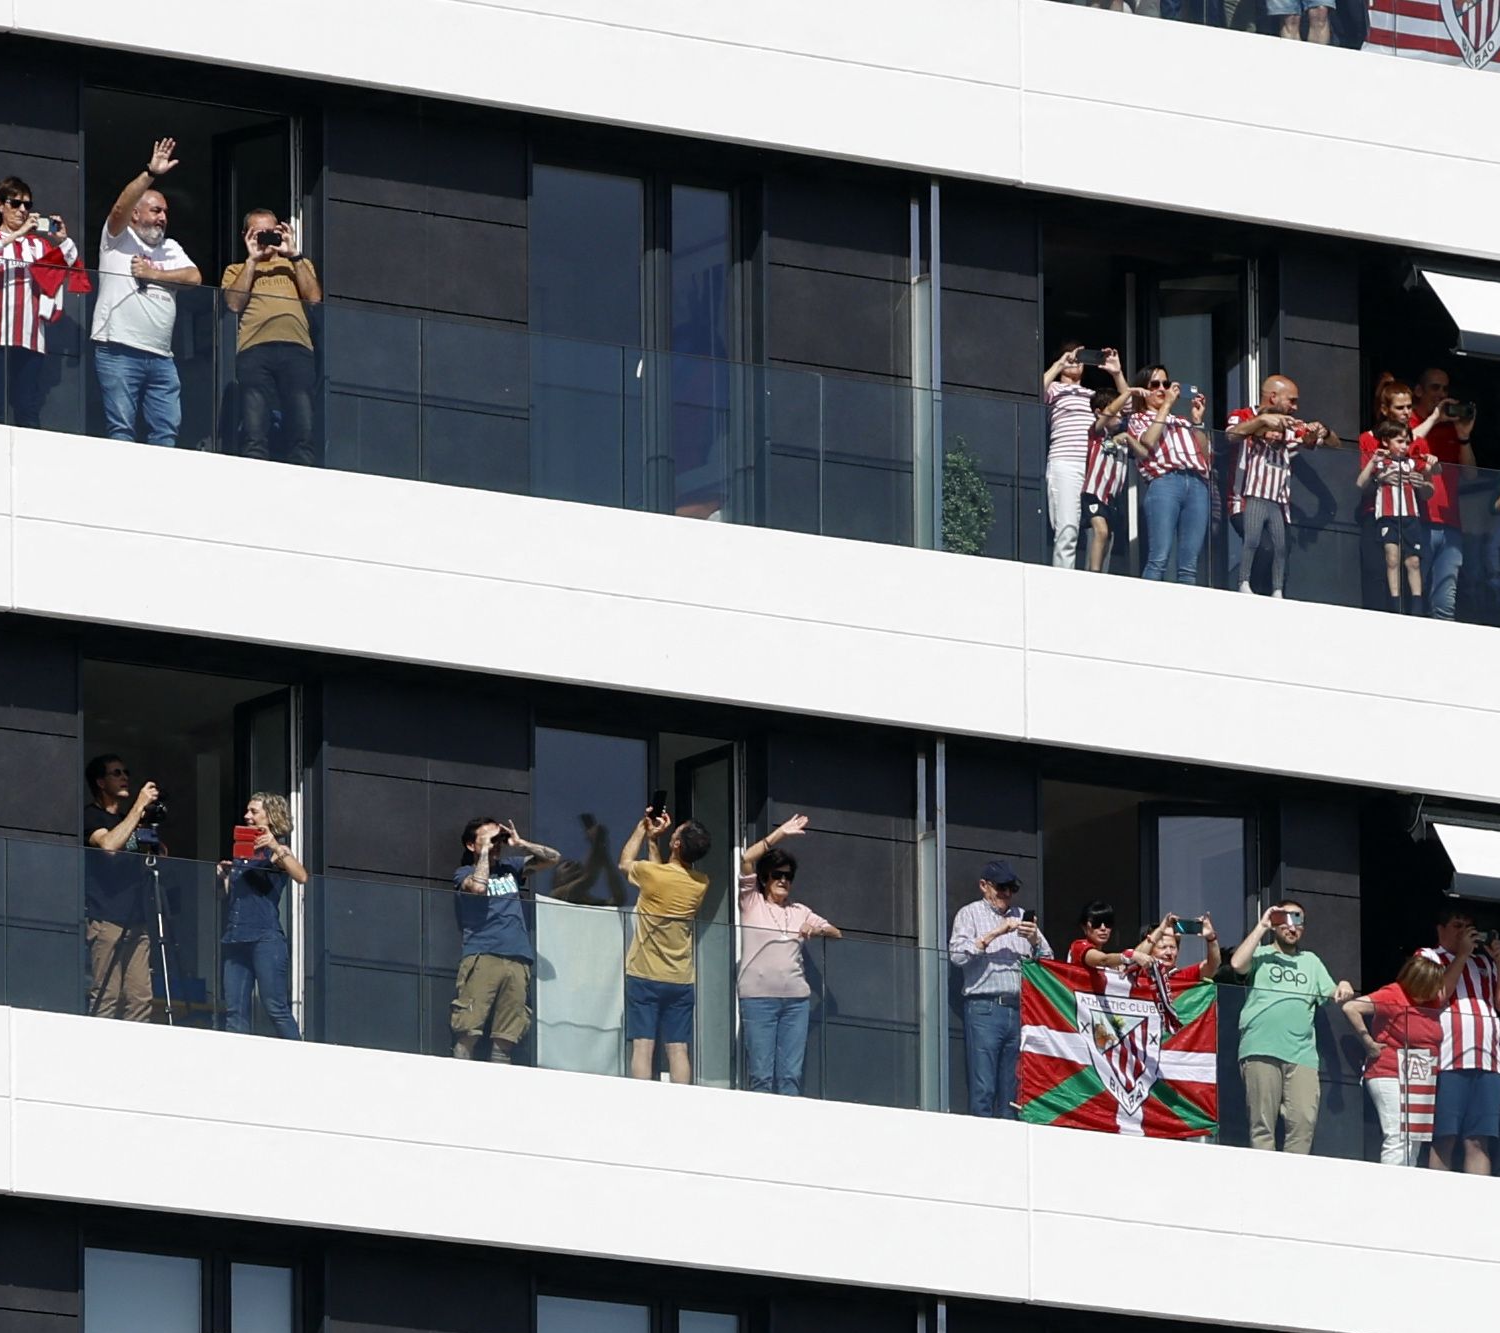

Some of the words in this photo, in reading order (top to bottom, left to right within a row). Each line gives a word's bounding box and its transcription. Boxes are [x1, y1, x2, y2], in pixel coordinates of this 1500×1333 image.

[1268, 965, 1307, 987] gap
[1080, 996, 1125, 1011] ATHLETIC
[1127, 1003, 1157, 1014] CLUB
